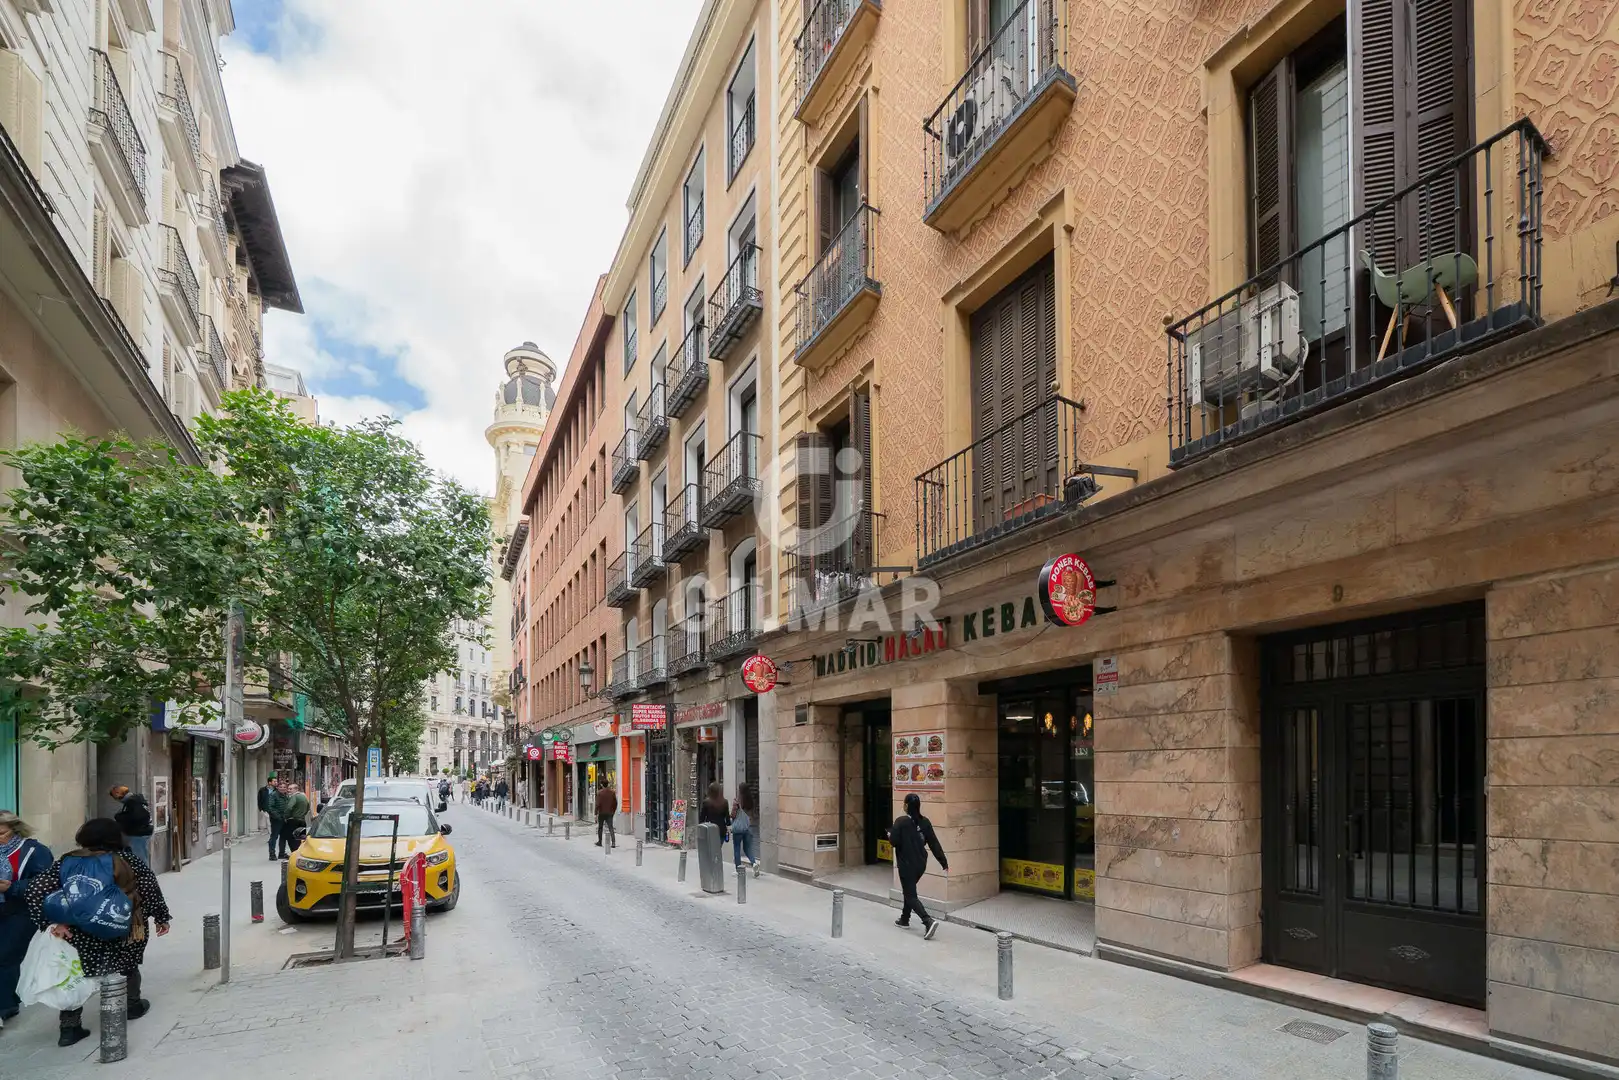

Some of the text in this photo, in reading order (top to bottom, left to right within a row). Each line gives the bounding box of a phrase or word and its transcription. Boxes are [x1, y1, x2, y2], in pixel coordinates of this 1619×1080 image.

[1051, 556, 1095, 589] DONER KEBAB
[1333, 584, 1344, 603] 9
[816, 642, 876, 677] MADRID
[963, 595, 1047, 642] KEBA
